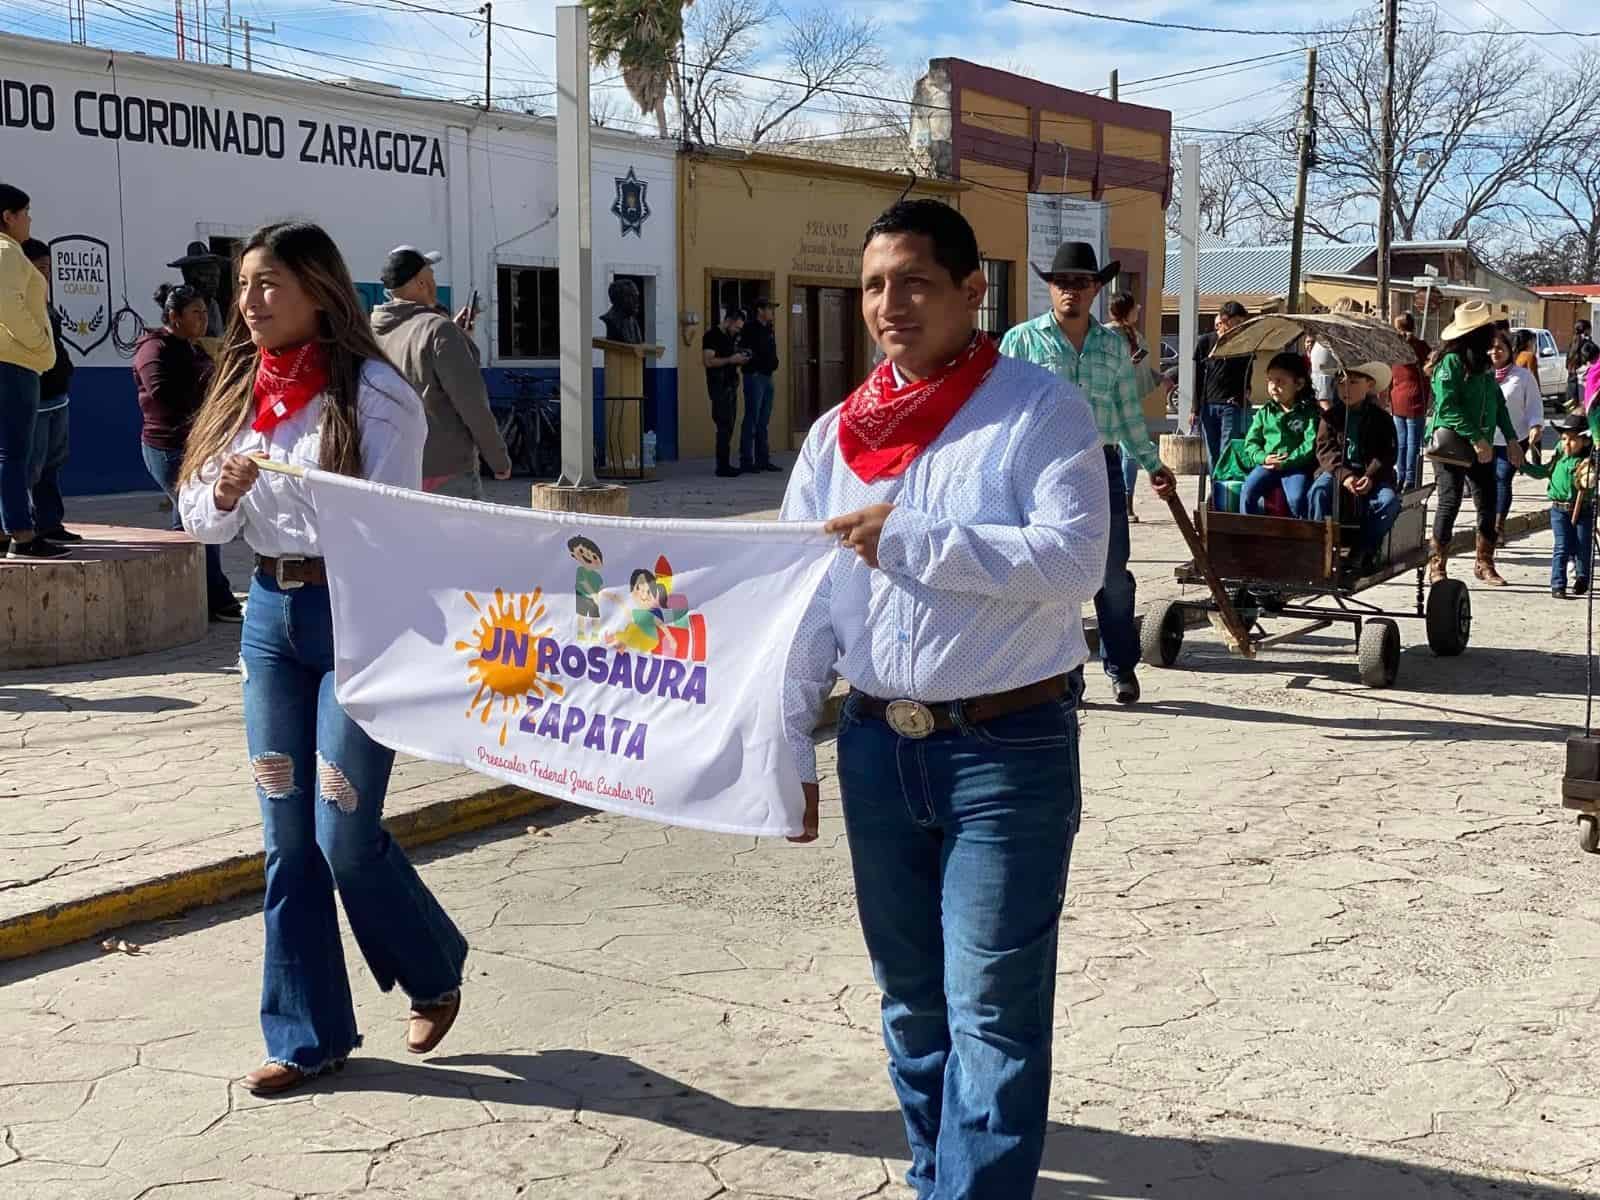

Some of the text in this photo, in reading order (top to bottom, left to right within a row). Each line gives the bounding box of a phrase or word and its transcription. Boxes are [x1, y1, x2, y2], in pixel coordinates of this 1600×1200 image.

[0, 79, 446, 178] DO COORDINADO ZARAGOZA
[57, 247, 103, 267] POLICÍA
[57, 267, 104, 282] ESTATAL
[481, 627, 707, 705] JN ROSAURA
[520, 696, 648, 760] ZAPATA
[477, 745, 528, 774] Preescolar
[530, 759, 567, 785] Federal
[569, 770, 594, 796] Zona
[597, 775, 633, 801] Escolar
